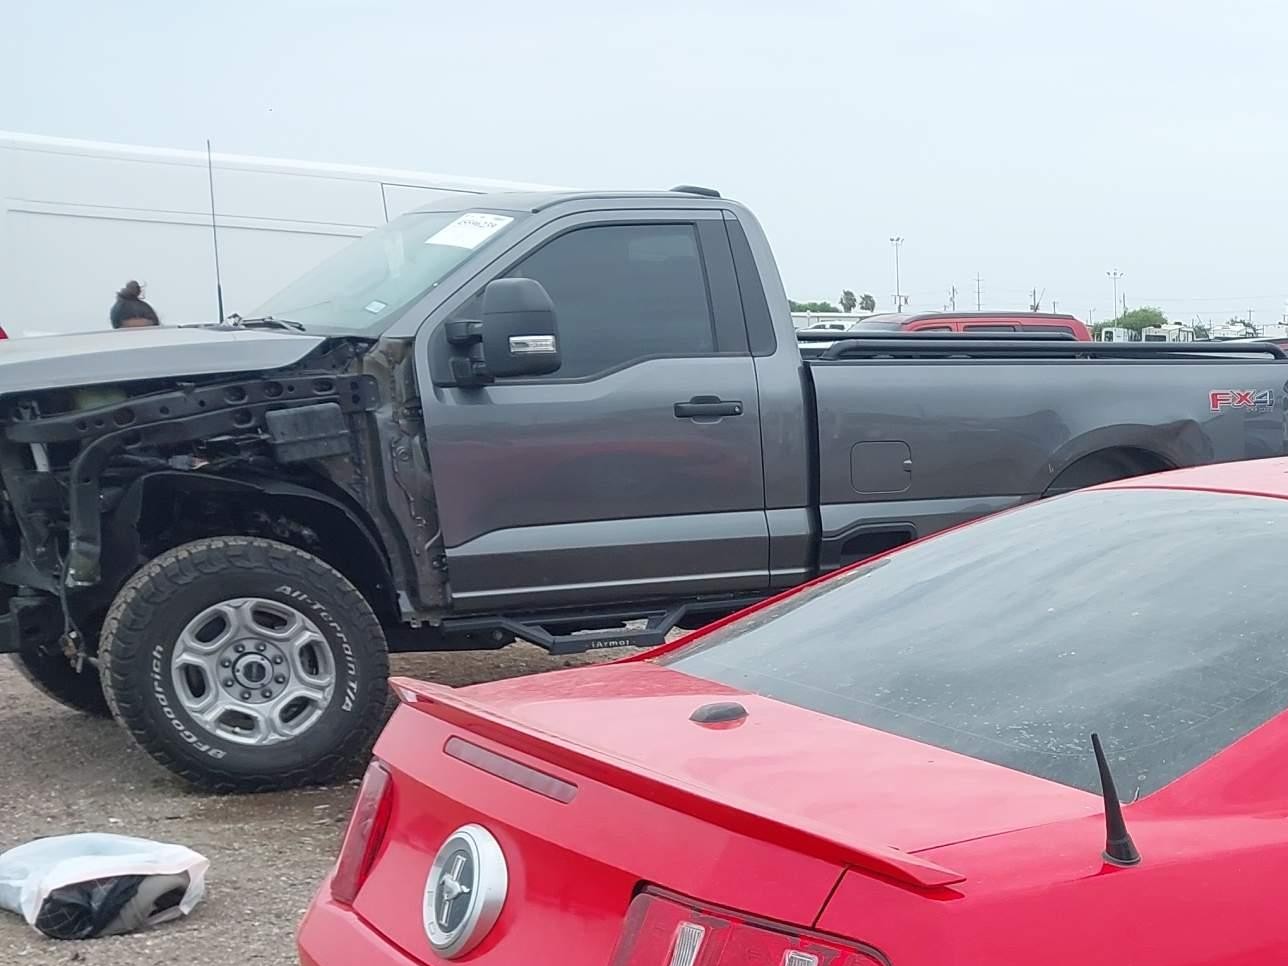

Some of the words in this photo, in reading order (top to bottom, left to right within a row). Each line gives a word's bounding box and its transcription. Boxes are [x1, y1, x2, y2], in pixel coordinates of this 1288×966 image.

[1209, 389, 1275, 412] FX4
[150, 645, 227, 759] BFGoodrich
[341, 680, 358, 712] T/A
